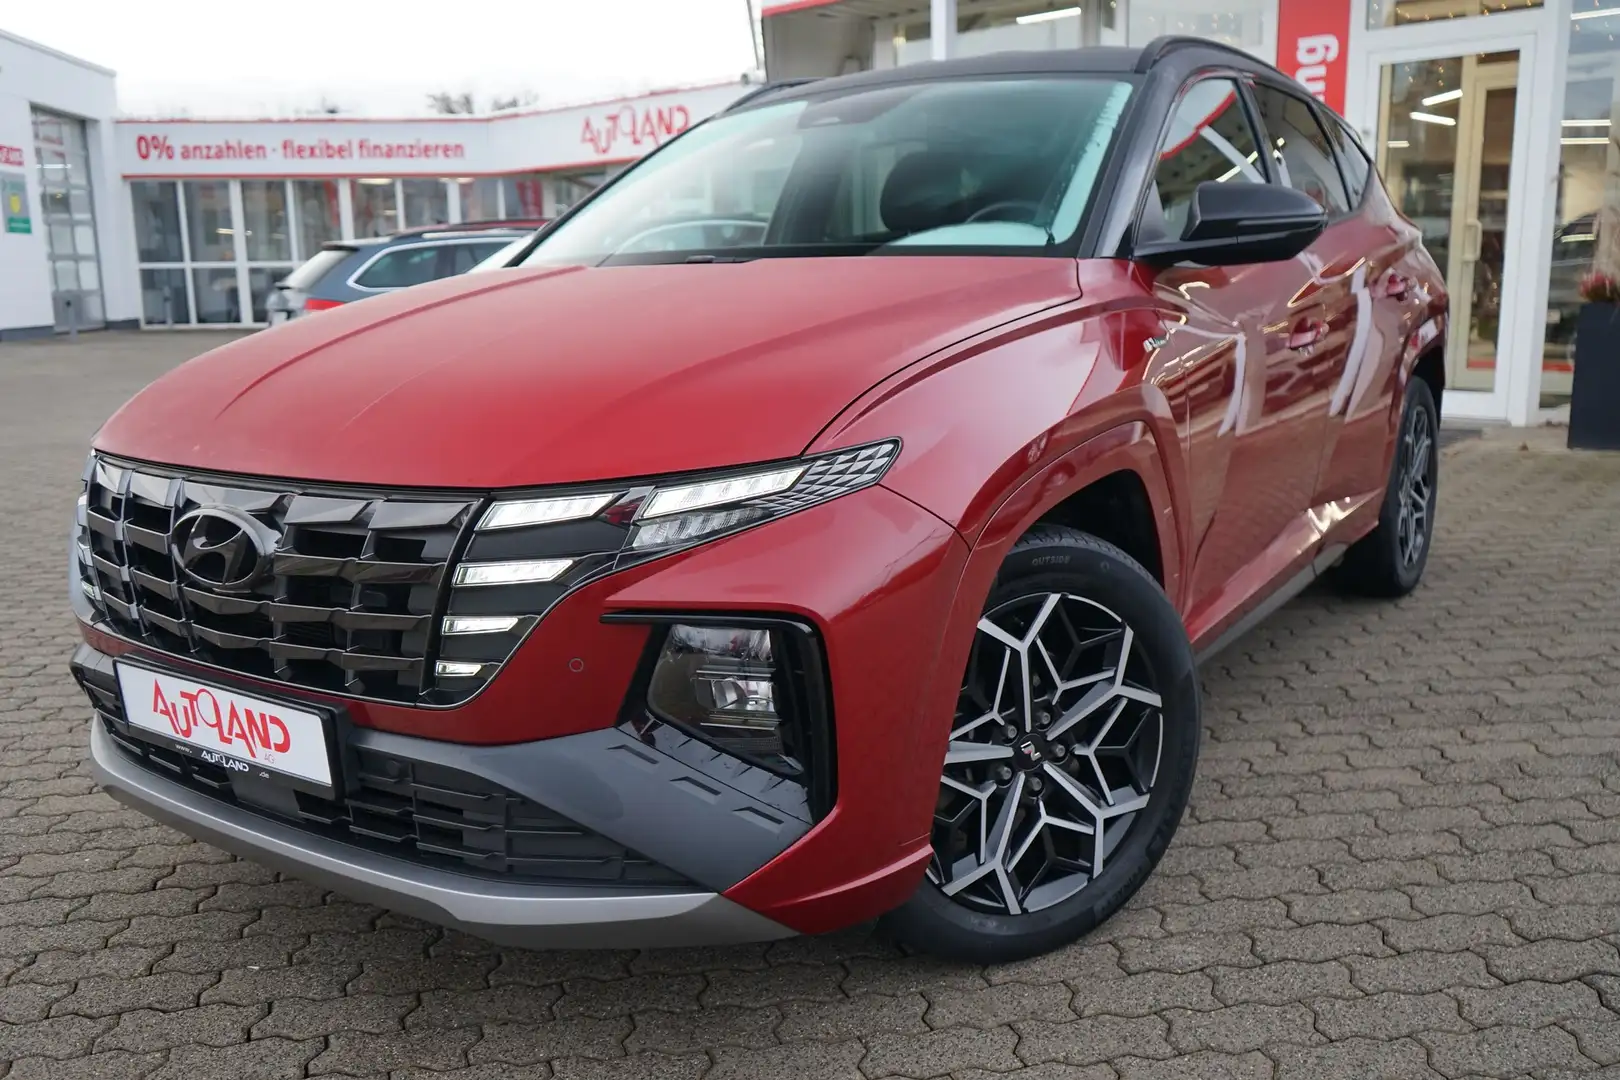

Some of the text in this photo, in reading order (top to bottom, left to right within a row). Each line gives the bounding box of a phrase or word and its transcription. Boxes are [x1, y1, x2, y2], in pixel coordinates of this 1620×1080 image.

[1295, 33, 1339, 102] ng
[136, 134, 464, 160] 0% anzahlen flexibel finanzieren
[1032, 555, 1071, 566] OUTSIDE
[153, 678, 291, 759] AUTOLAND
[201, 750, 249, 772] AUTOLAND
